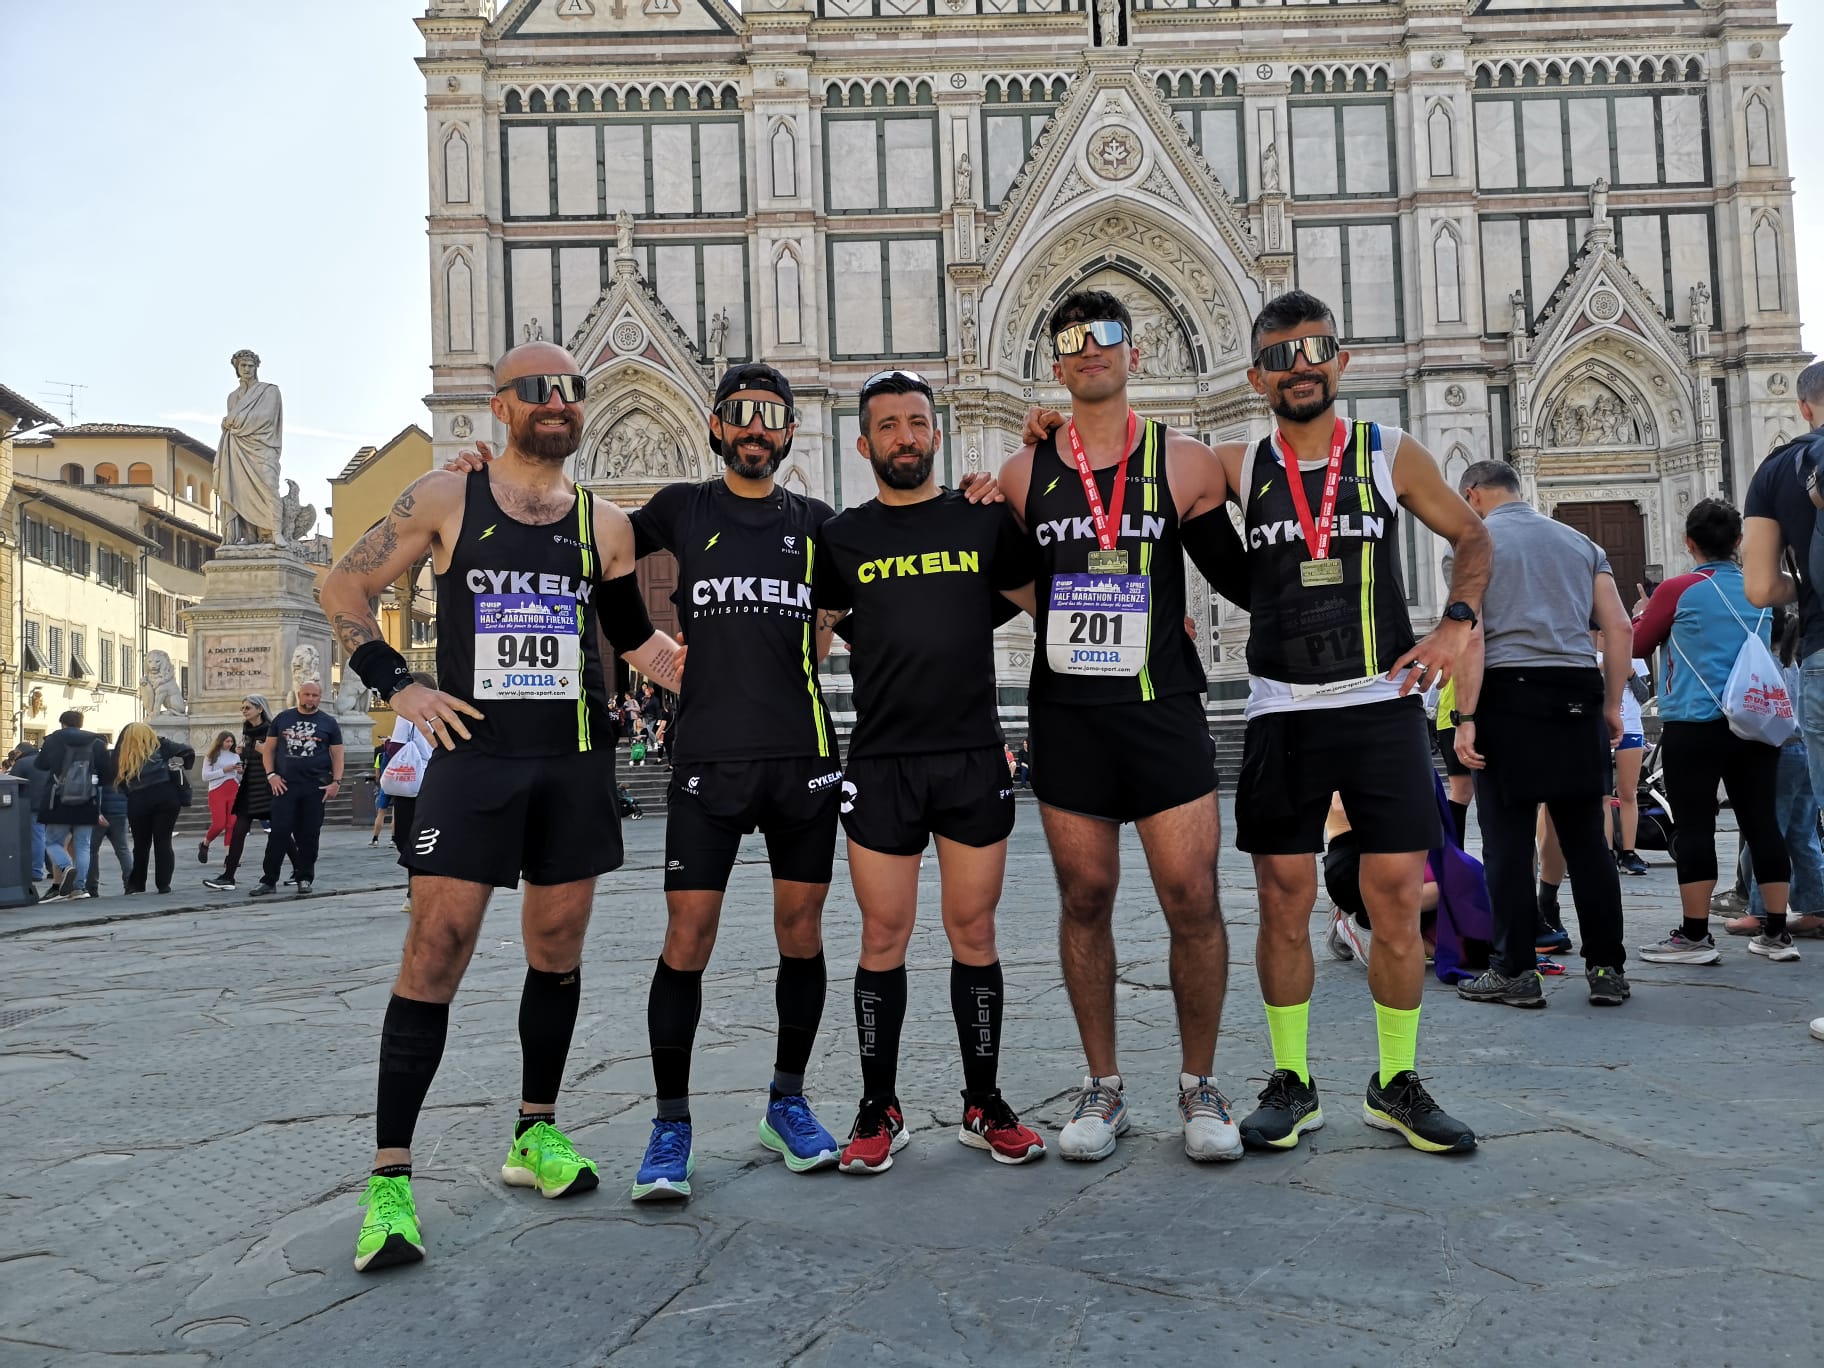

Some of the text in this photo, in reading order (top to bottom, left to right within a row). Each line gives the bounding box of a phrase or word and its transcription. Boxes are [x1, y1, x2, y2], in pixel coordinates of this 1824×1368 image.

[1035, 514, 1166, 547] CYKLN
[857, 550, 979, 584] CYKELN
[466, 568, 594, 604] CYKELN
[692, 576, 812, 610] CYKELN
[1054, 592, 1145, 603] HALF MARATHON FIRENZE
[546, 614, 575, 625] FIRENZE
[693, 606, 769, 619] DIVISIONE
[1069, 612, 1123, 645] 201
[498, 635, 559, 668] 949
[1068, 664, 1131, 673] www.joma-sport.com
[498, 689, 566, 697] www.joma-sport.com
[857, 988, 882, 1057] kalenji
[970, 986, 997, 1057] kalenji
